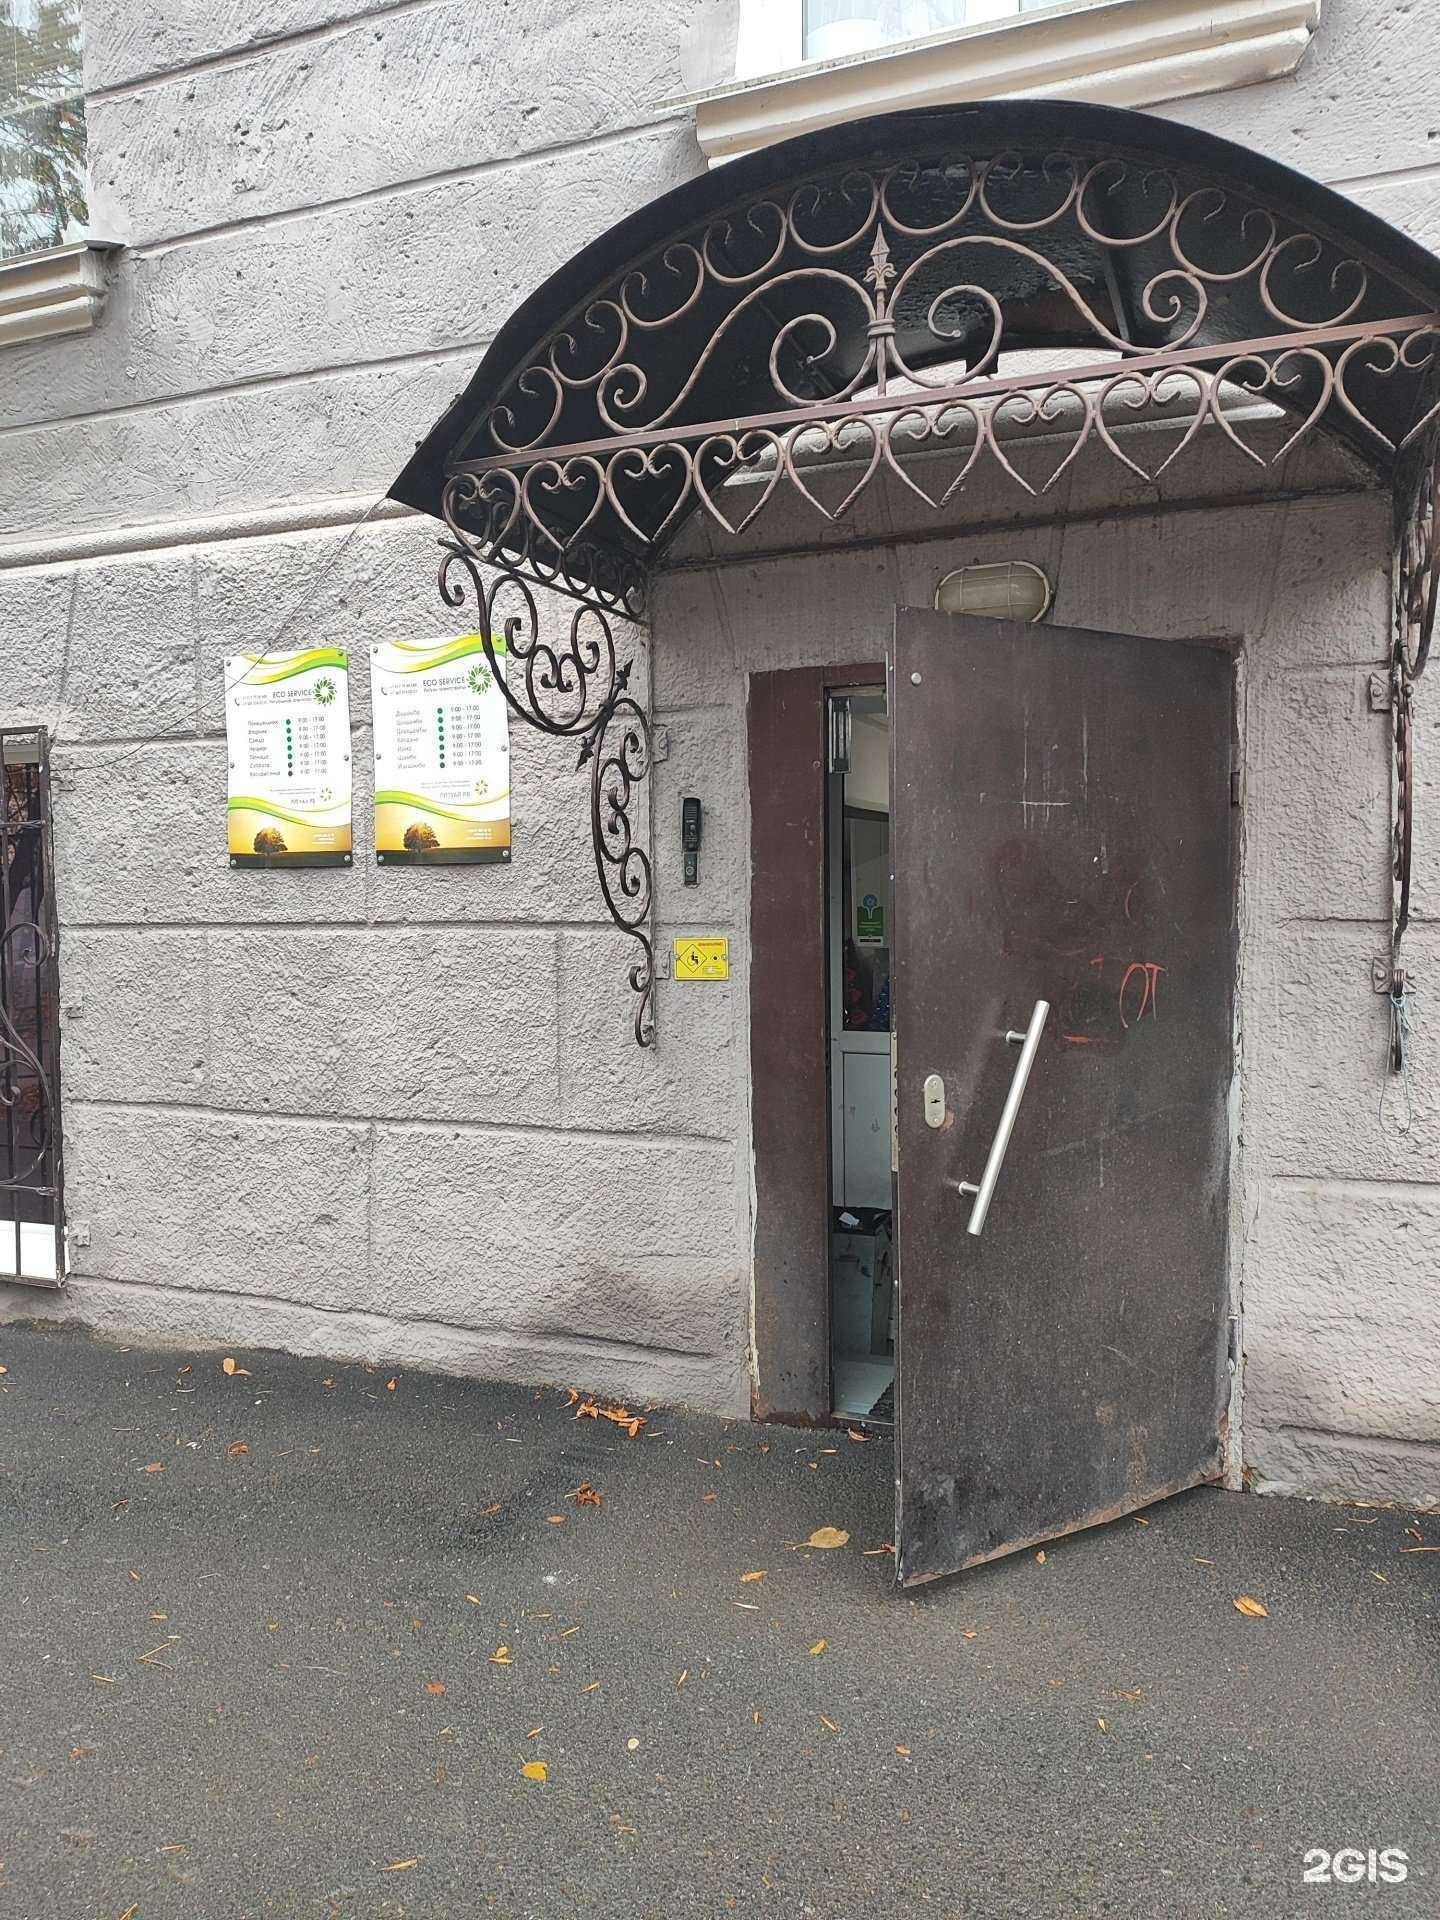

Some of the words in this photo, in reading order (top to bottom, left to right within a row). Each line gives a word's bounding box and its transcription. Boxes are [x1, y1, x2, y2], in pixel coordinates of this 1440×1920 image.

[422, 679, 438, 687] ECO
[438, 676, 465, 686] SERVICE
[272, 691, 286, 699] ECO
[287, 688, 312, 698] SERVICE
